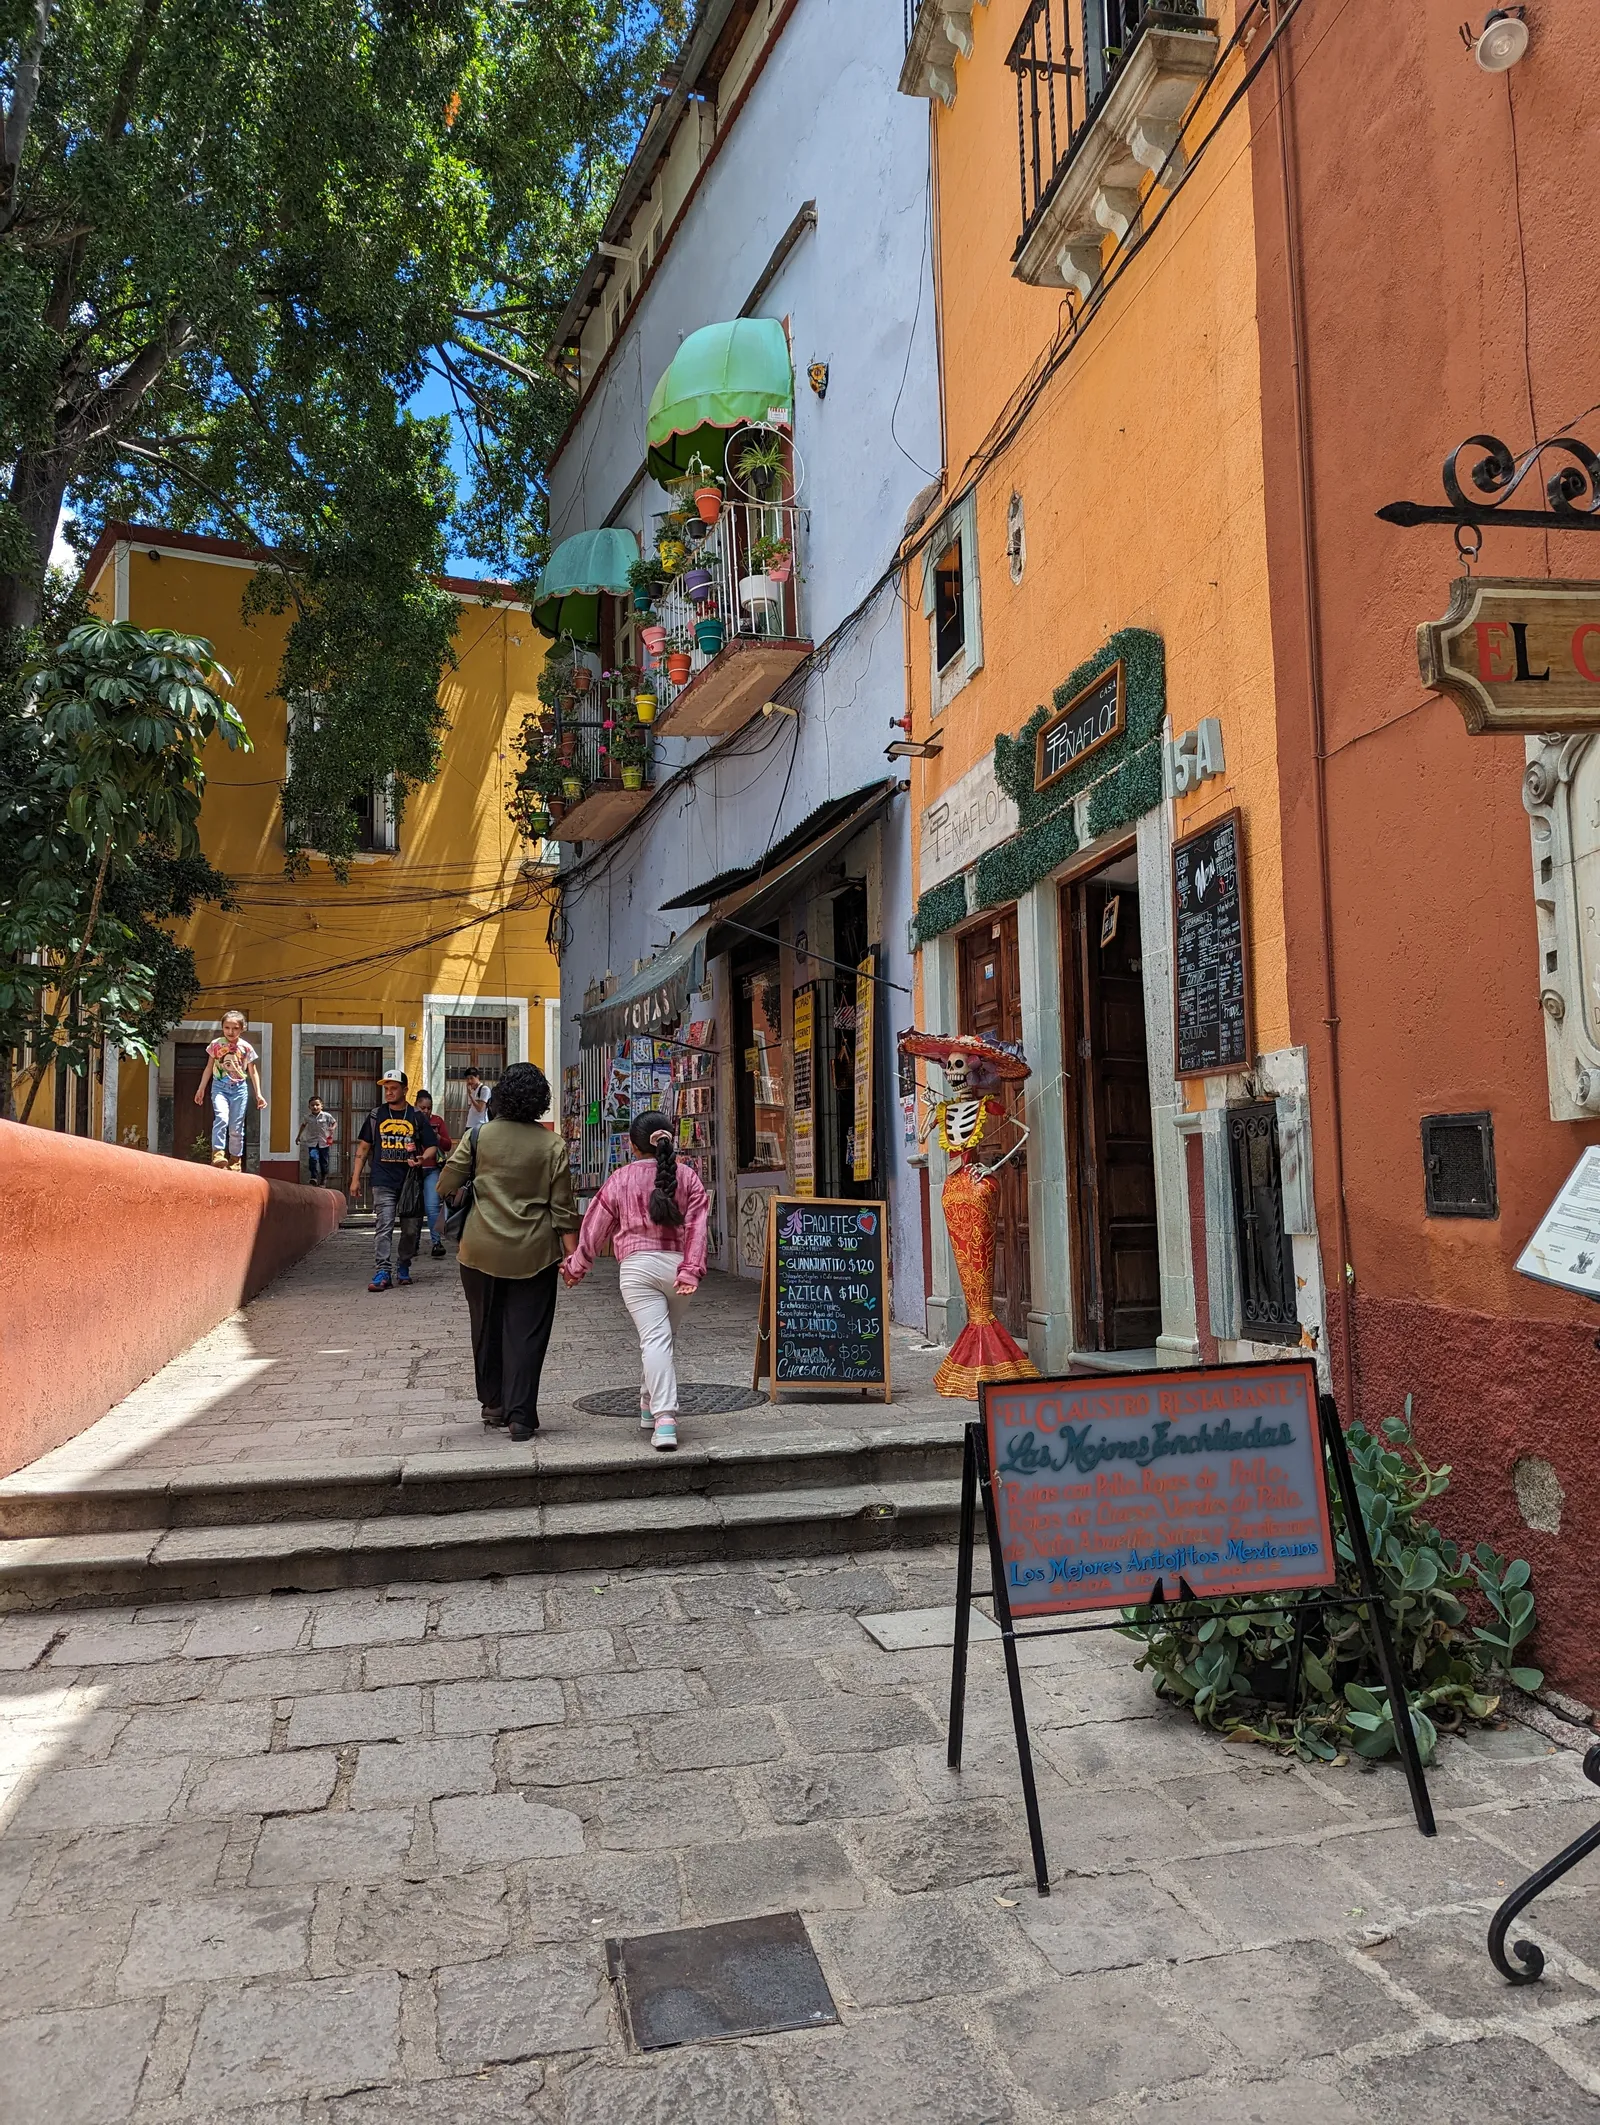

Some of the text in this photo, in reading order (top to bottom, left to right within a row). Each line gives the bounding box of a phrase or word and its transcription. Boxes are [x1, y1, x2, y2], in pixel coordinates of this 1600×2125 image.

[1473, 621, 1550, 682] EL
[1099, 679, 1117, 699] CASA
[792, 1235, 833, 1248] DESPERTAR
[786, 1257, 875, 1273] GUANAJUATITO $120
[787, 1283, 869, 1301] AZTECA $140
[786, 1318, 798, 1330] AL
[846, 1316, 880, 1334] $135
[838, 1342, 872, 1362] $85
[998, 1416, 1297, 1476] Las Mejores Enchiladas
[1005, 1482, 1060, 1513] Rojas
[1064, 1484, 1093, 1499] con
[1141, 1467, 1190, 1499] Rojas
[1195, 1465, 1218, 1490] de
[1008, 1508, 1062, 1538] Rojas
[1066, 1507, 1092, 1528] de
[1162, 1492, 1228, 1519] Verdes
[1231, 1489, 1254, 1513] de
[1003, 1539, 1026, 1563] de
[1025, 1532, 1076, 1558] Nata
[1010, 1538, 1319, 1588] Los Mejores Antojitos Mexicanos
[1203, 1561, 1267, 1580] CARTA
